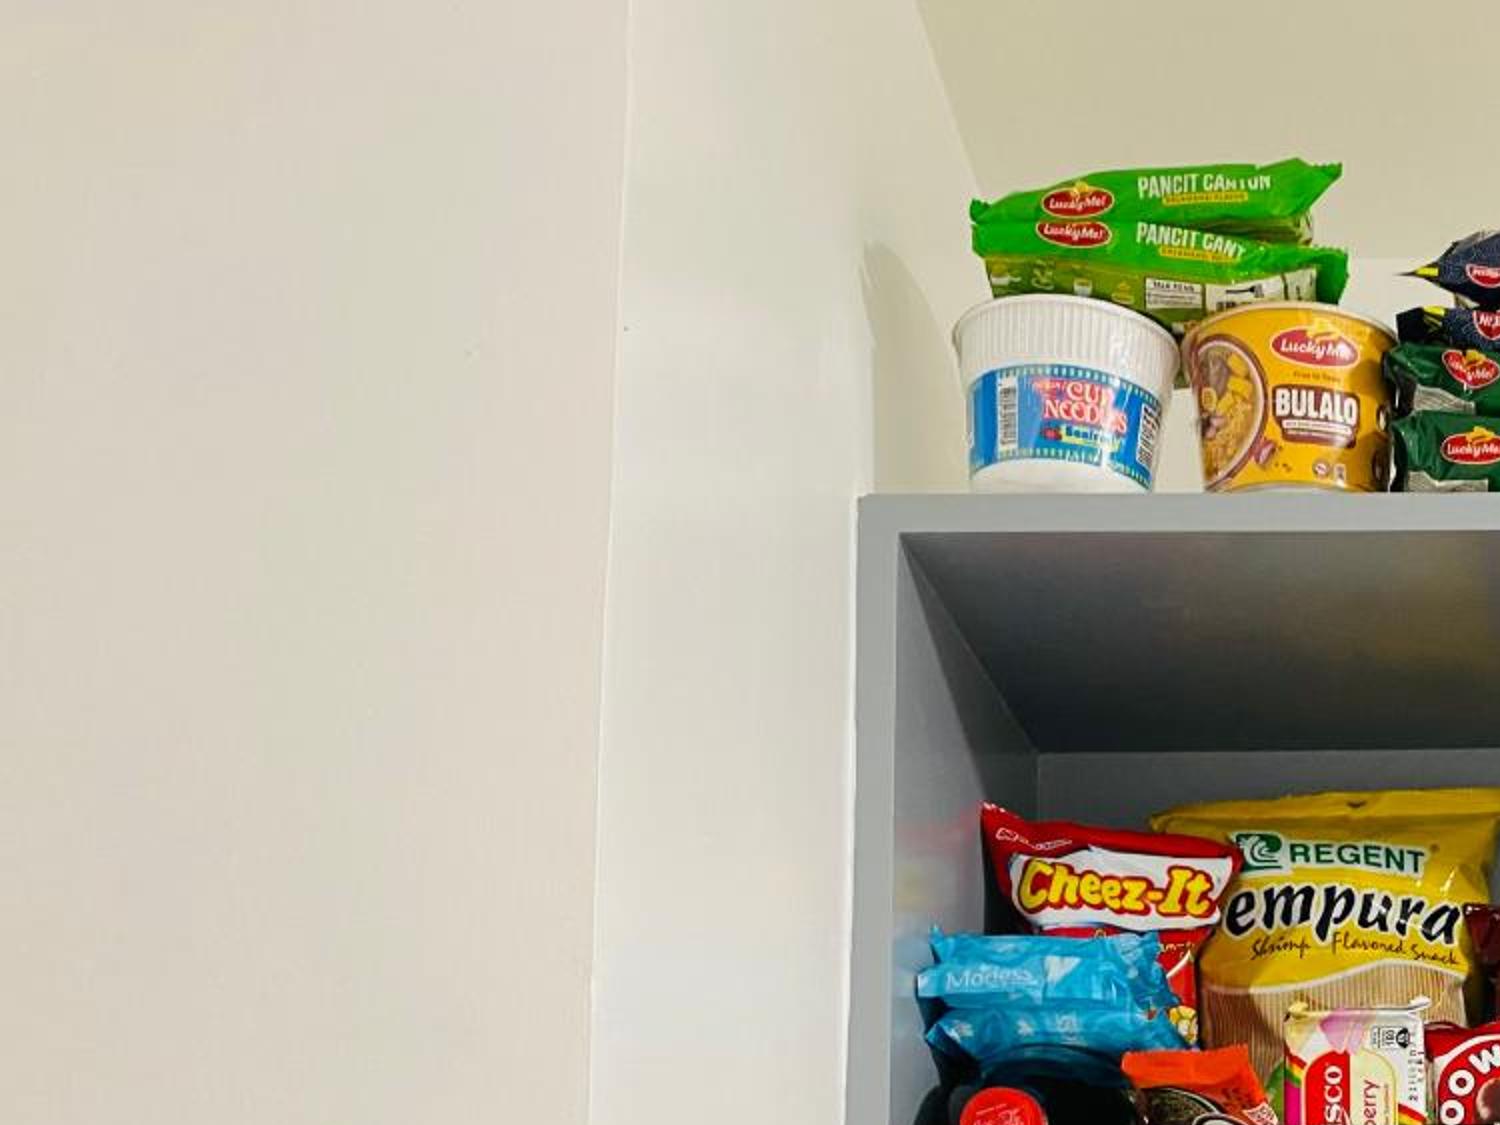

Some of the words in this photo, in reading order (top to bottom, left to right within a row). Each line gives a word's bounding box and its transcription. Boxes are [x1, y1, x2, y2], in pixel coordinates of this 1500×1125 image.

[1138, 174, 1200, 198] PANCIT
[1136, 221, 1200, 247] PANCIT
[1275, 387, 1358, 425] BULALO
[1289, 843, 1426, 874] REGENT
[1020, 859, 1214, 918] Cheez-It
[1225, 883, 1463, 946] empura
